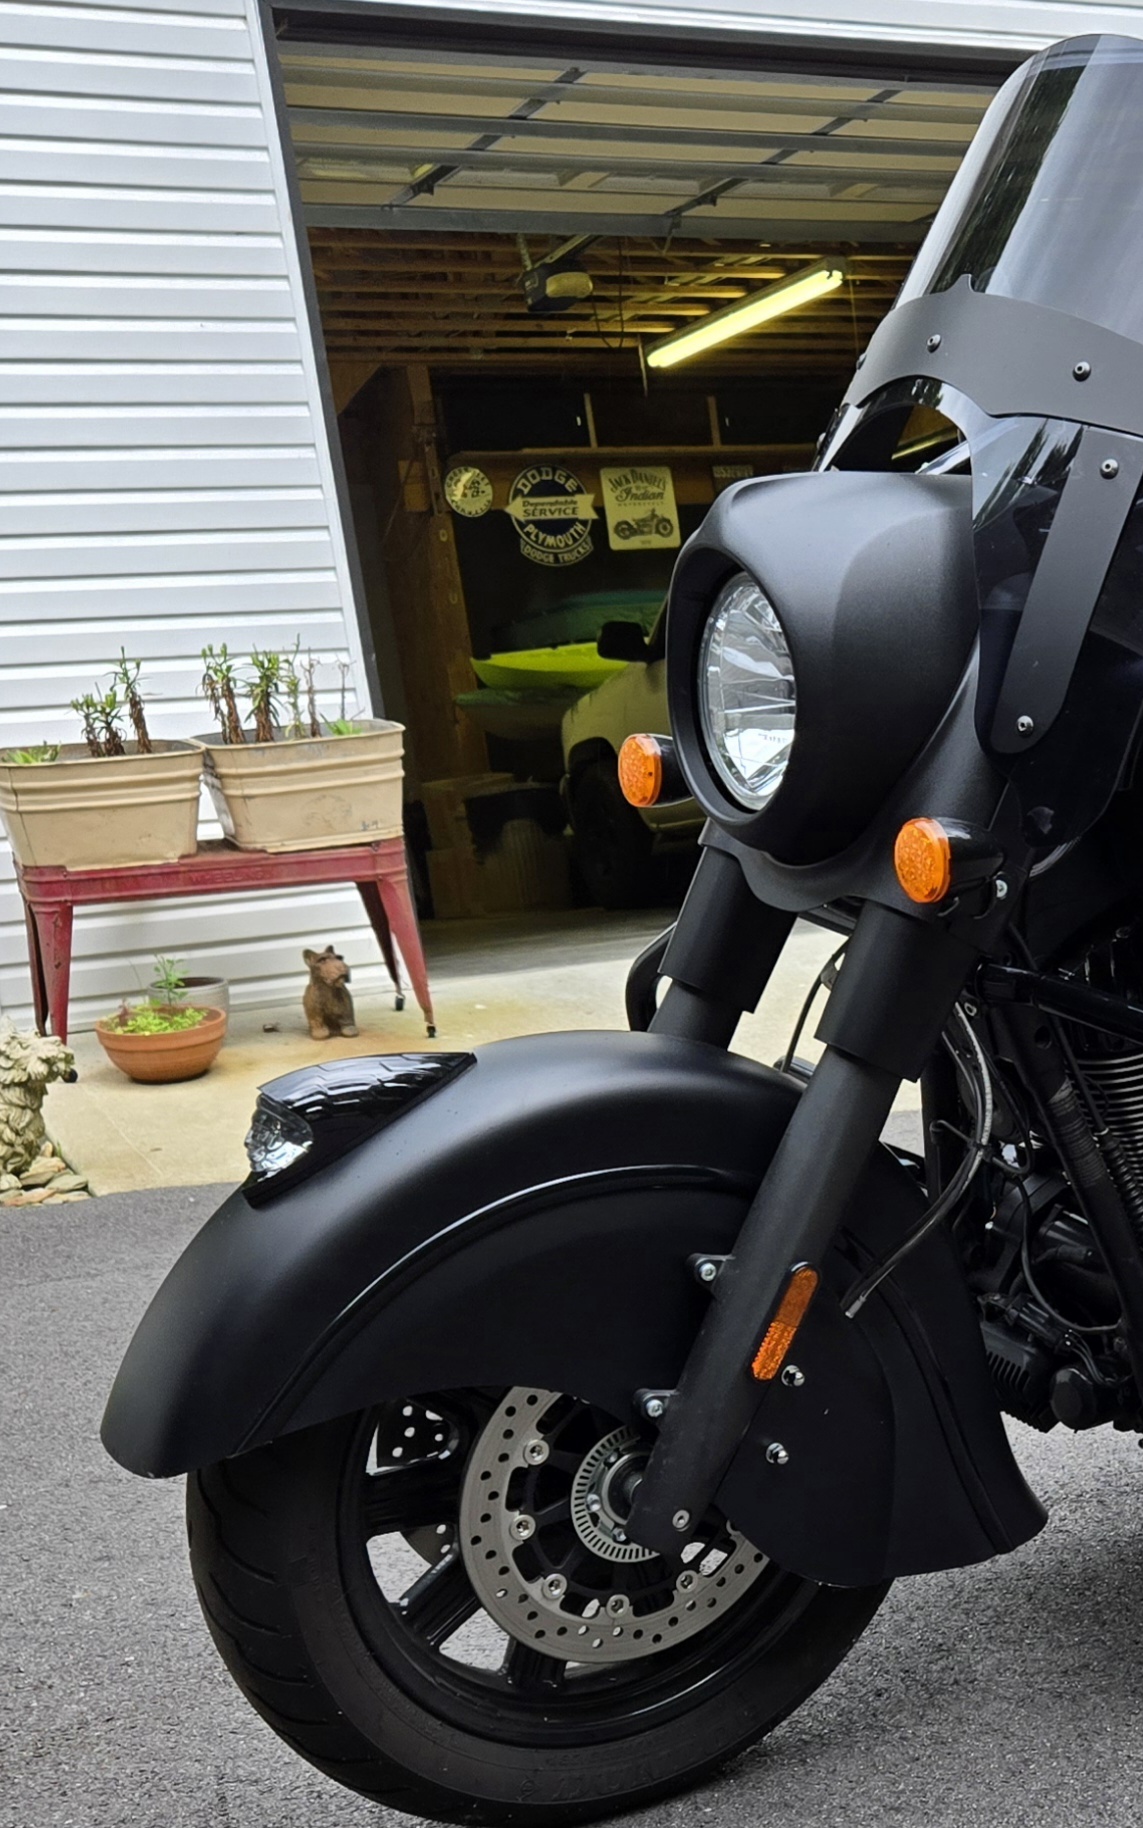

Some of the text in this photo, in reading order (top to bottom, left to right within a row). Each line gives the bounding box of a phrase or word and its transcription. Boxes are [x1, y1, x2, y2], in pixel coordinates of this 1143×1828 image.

[517, 467, 578, 495] DODGE
[608, 473, 631, 493] JACK
[522, 499, 578, 509] Dependable
[615, 487, 665, 502] Indian
[522, 506, 579, 518] SERVICE
[523, 521, 586, 549] PLYMOUTH
[524, 540, 591, 563] DODGE TRUCKS
